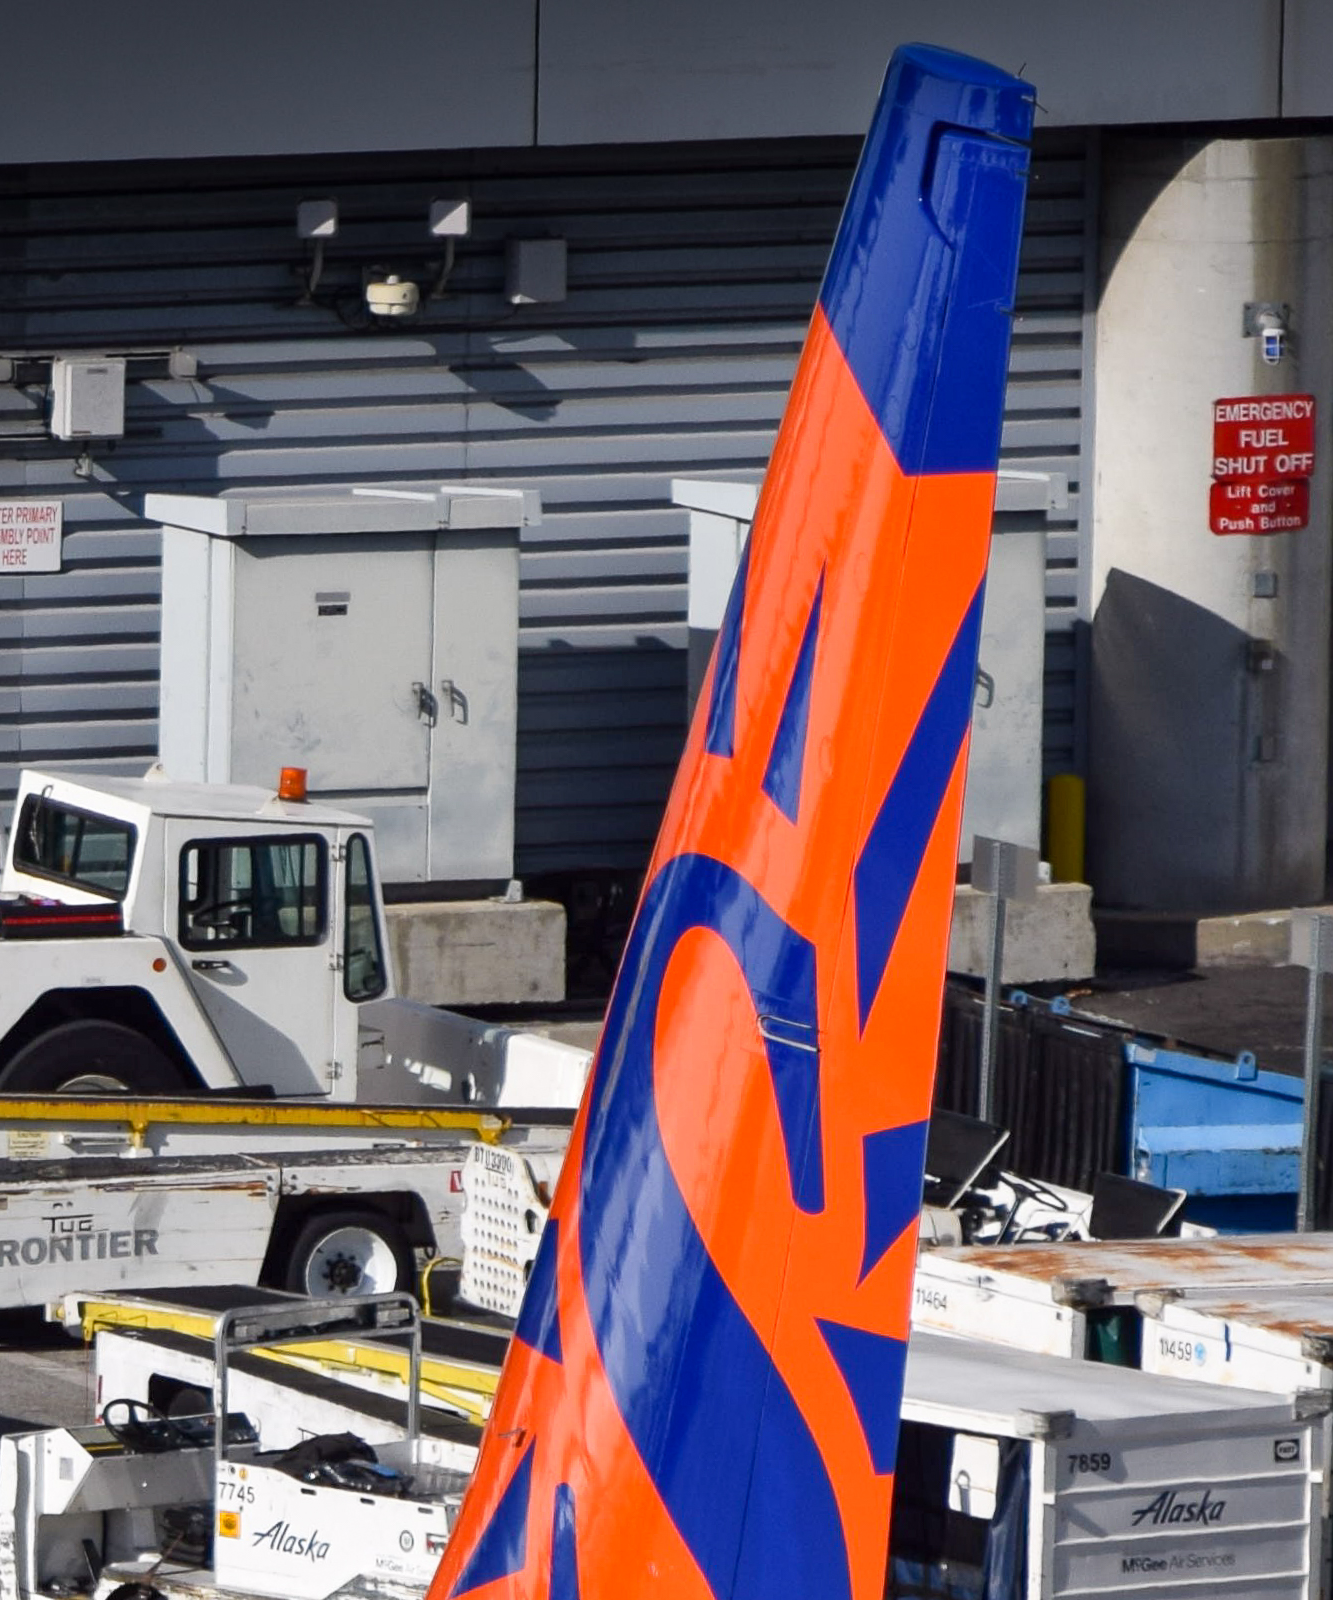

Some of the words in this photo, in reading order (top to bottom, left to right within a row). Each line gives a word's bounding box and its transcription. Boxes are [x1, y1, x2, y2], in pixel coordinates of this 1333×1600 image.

[1216, 401, 1314, 422] EMERGENCY
[1239, 429, 1290, 448] FUEL
[1215, 455, 1268, 475] SHUT
[1276, 453, 1314, 472] OFF
[1227, 485, 1251, 498] Lift
[1258, 484, 1295, 497] Cover
[16, 506, 58, 523] PRIMARY
[1251, 502, 1276, 514] and
[1219, 517, 1254, 531] Push
[1260, 516, 1301, 530] Button
[26, 528, 55, 544] POINT
[2, 549, 27, 565] HERE
[915, 1288, 948, 1311] 11464
[1159, 1337, 1193, 1362] 11459
[1068, 1453, 1111, 1473] 7859
[218, 1482, 255, 1504] 7745
[1132, 1489, 1227, 1527] Alaska
[252, 1520, 331, 1562] Alaska
[1170, 1556, 1183, 1569] Air
[1185, 1553, 1236, 1568] Services
